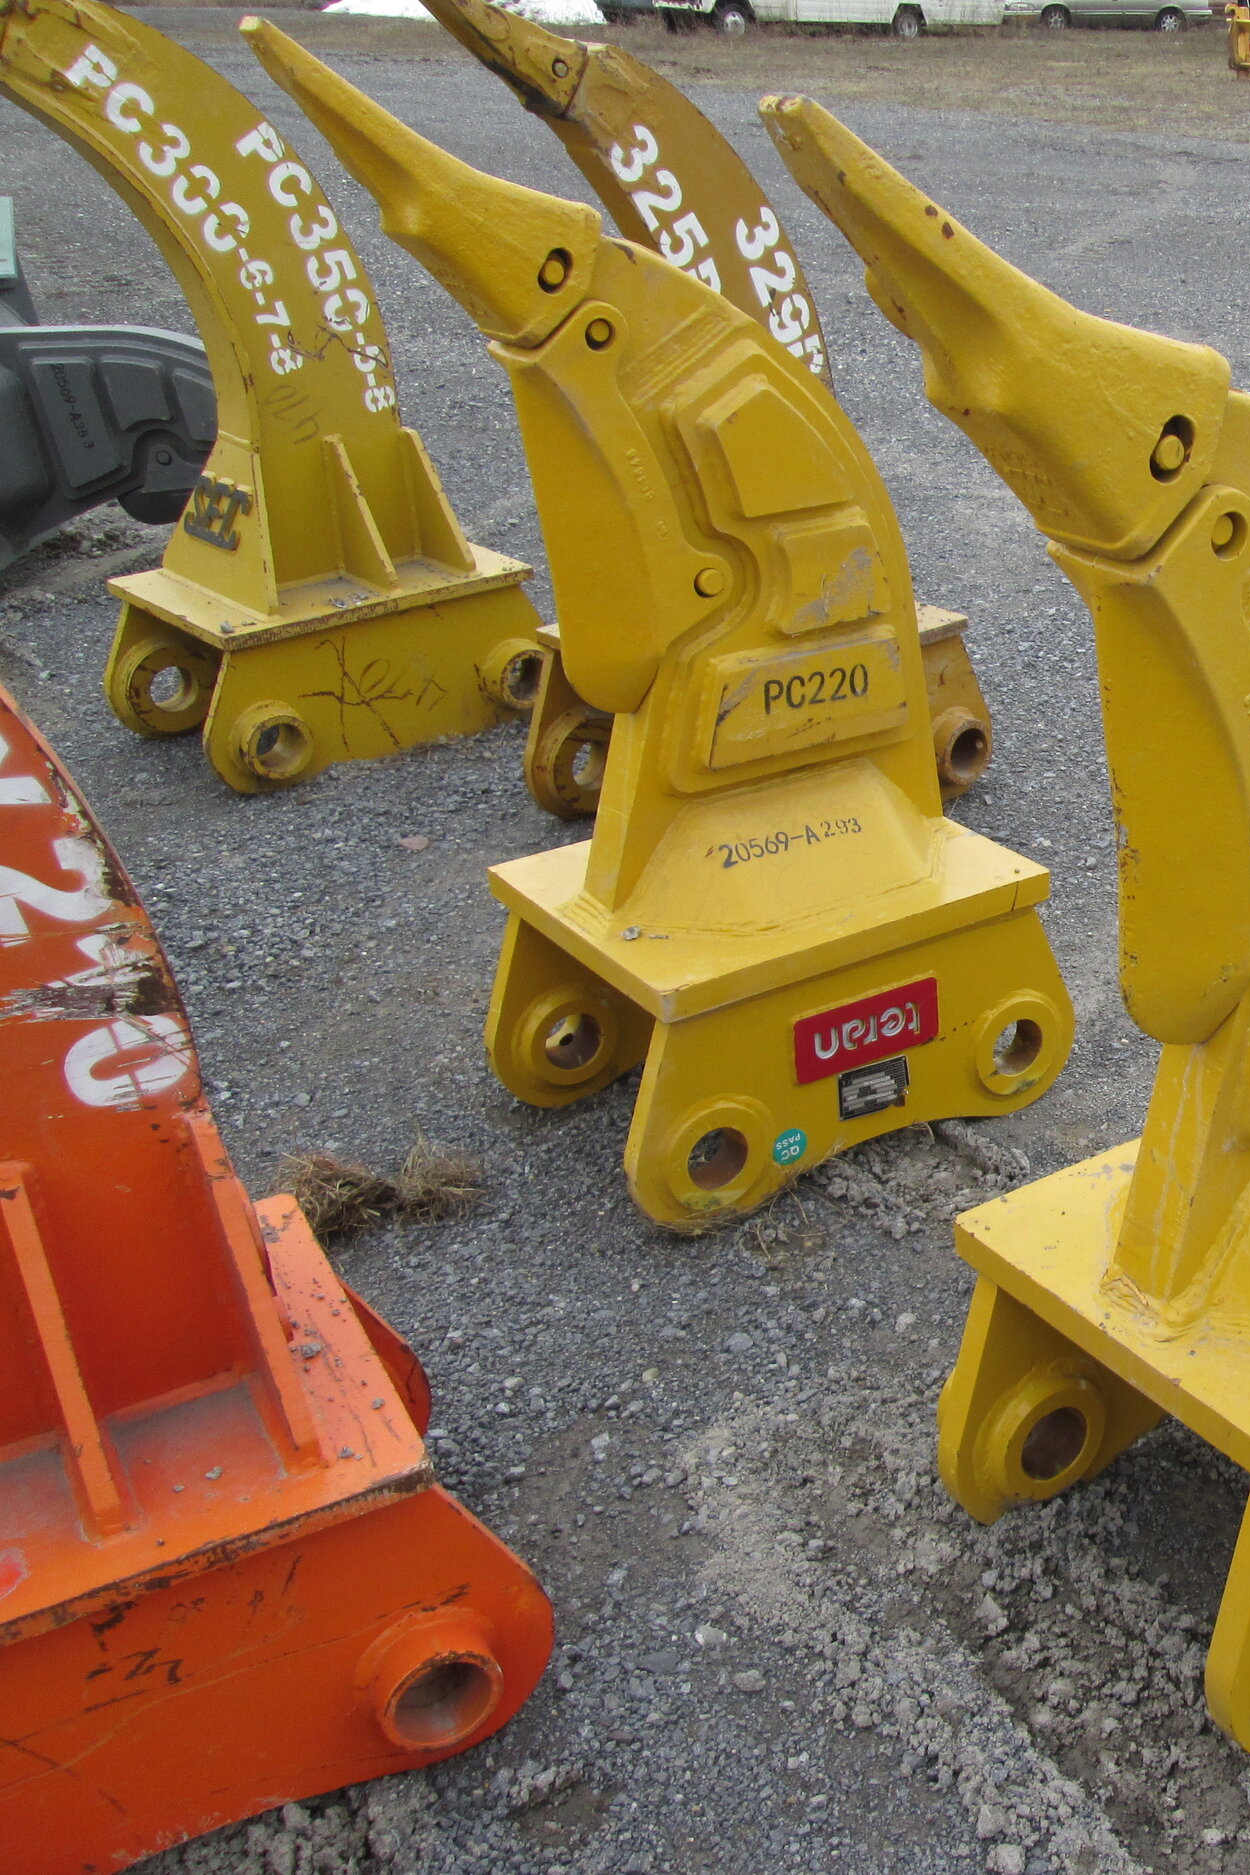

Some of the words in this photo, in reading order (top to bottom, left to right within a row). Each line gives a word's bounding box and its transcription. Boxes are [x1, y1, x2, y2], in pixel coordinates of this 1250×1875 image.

[65, 44, 303, 375] PC300-6-7-8
[763, 663, 869, 715] PC220
[718, 817, 862, 869] 20569-A293
[814, 1001, 920, 1060] teran
[777, 1133, 801, 1150] PASS
[781, 1145, 800, 1160] QC
